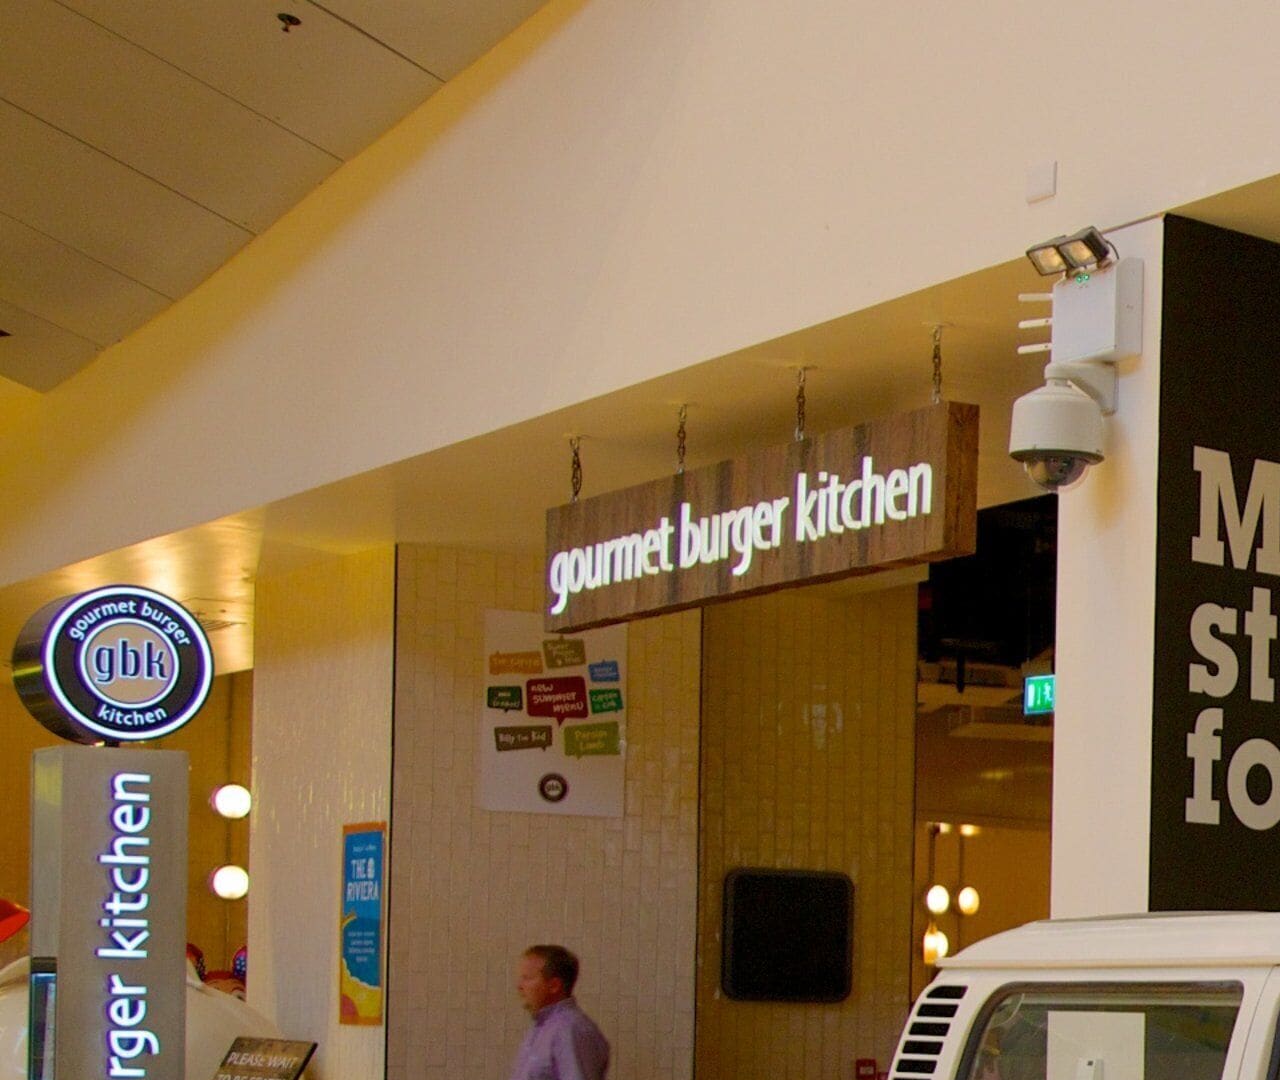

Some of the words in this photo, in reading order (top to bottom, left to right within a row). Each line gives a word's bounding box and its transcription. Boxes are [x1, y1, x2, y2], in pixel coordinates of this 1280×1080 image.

[550, 516, 675, 614] gourmet
[680, 496, 789, 576] burger
[796, 455, 932, 542] kitchen
[69, 600, 137, 641] gourmet
[141, 601, 191, 646] burger
[93, 638, 167, 684] gbk
[98, 704, 167, 727] kitchen
[96, 771, 152, 959] kitchen
[351, 859, 367, 879] THE
[346, 881, 379, 901] RIVIERA
[227, 1052, 263, 1067] PLEASE
[267, 1057, 299, 1069] WAIT
